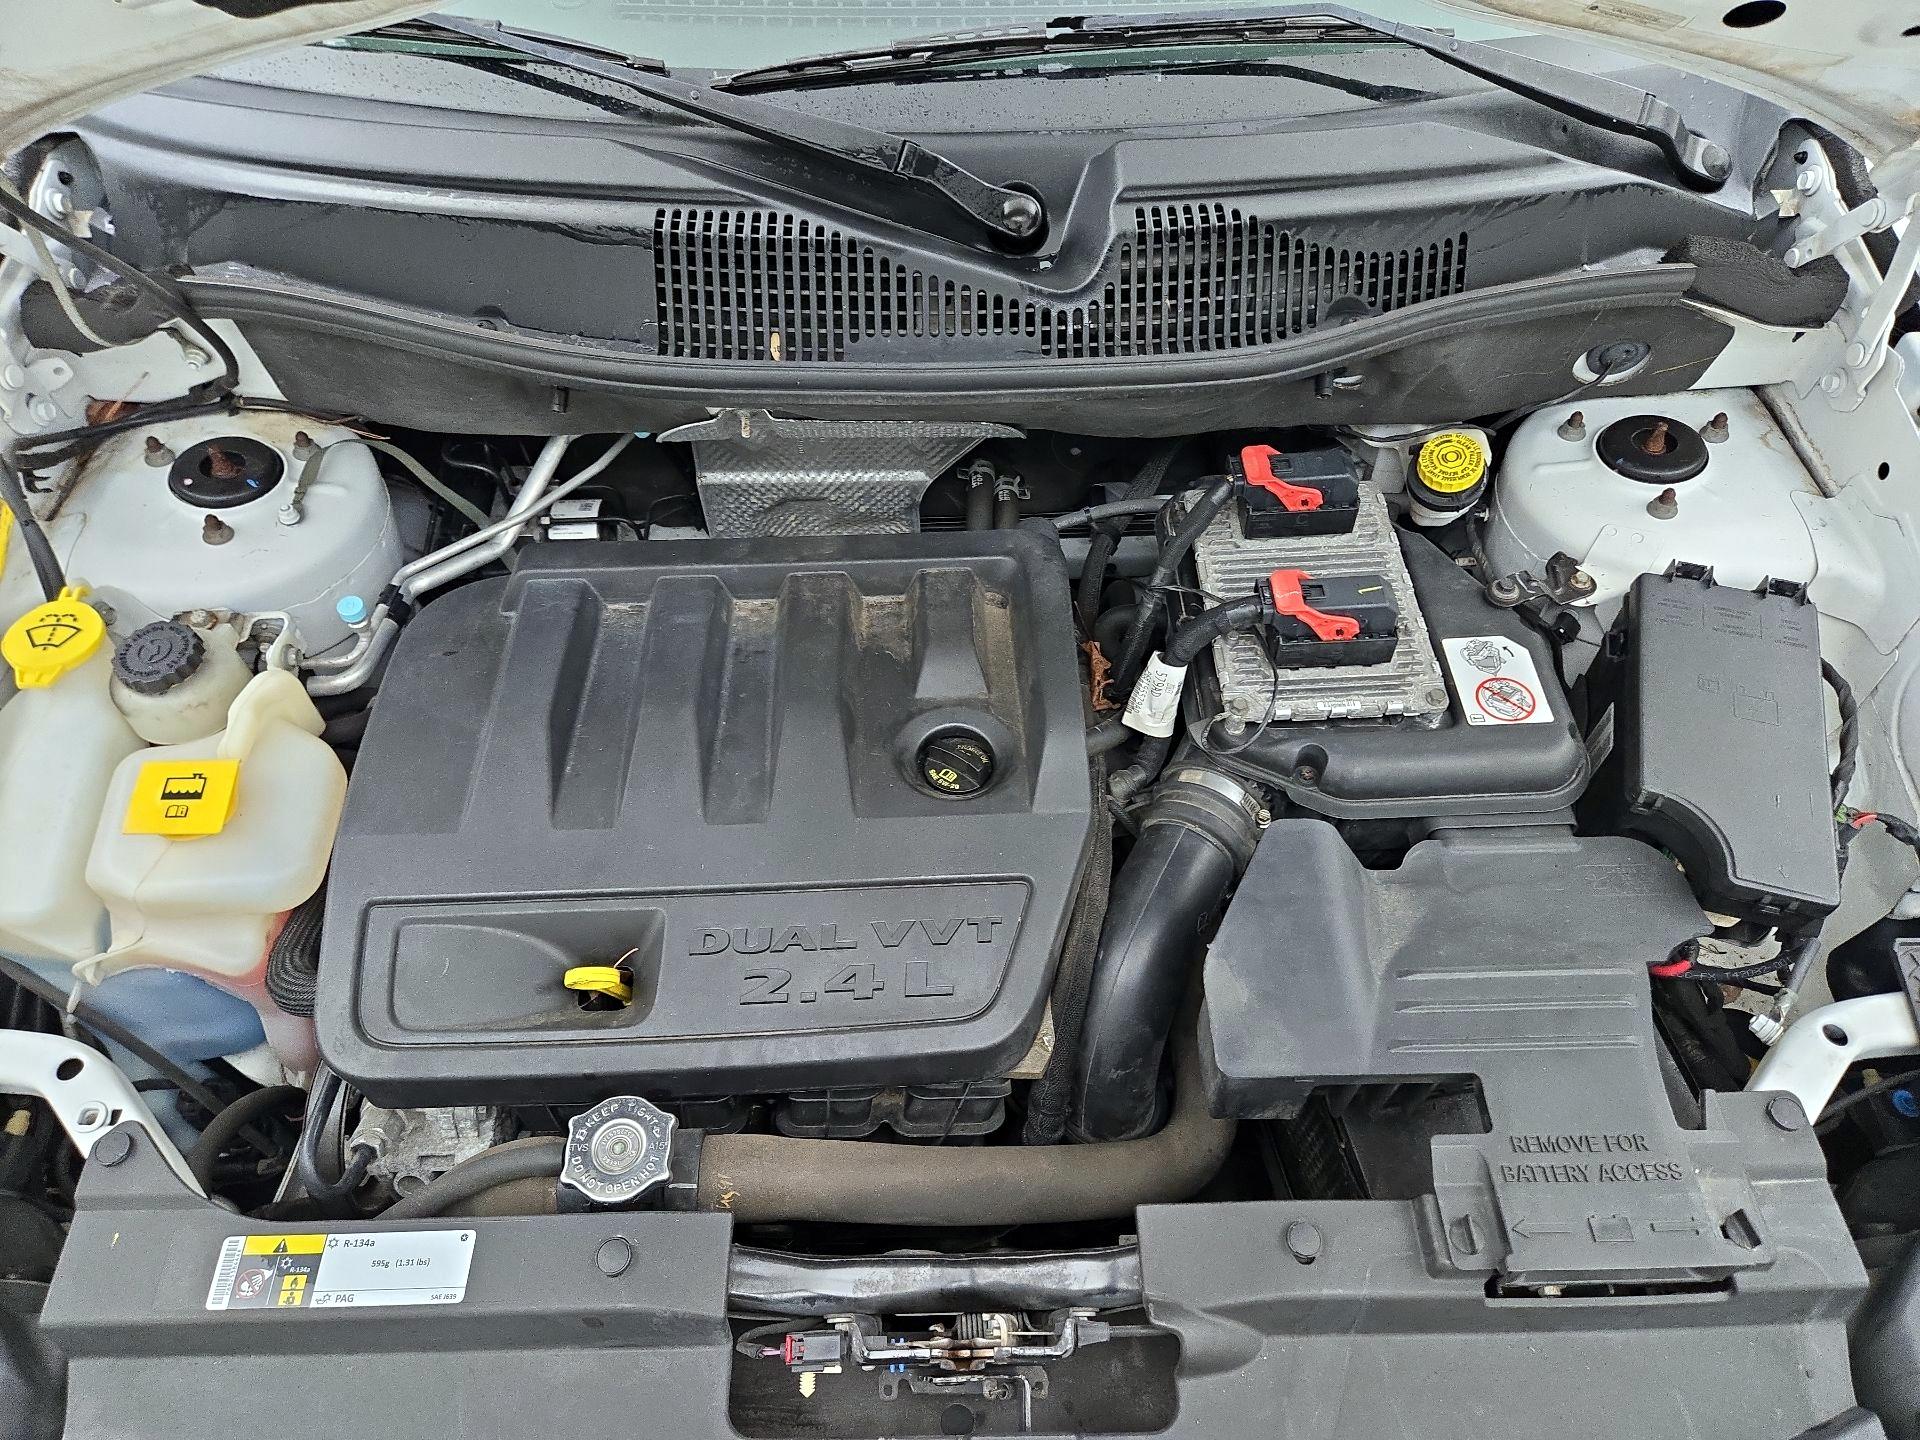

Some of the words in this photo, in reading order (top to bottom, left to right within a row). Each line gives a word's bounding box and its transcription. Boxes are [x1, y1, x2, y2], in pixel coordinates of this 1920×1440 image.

[929, 769, 941, 780] SAE
[937, 778, 960, 789] 5W-20
[689, 924, 857, 955] DUAL
[870, 916, 1003, 948] VVT
[739, 962, 885, 1006] 2.4
[904, 960, 954, 998] L
[585, 1103, 619, 1127] KEEP
[628, 1103, 659, 1125] TIGHT
[570, 1143, 589, 1152] TVS
[1509, 1134, 1601, 1153] REMOVE
[1603, 1134, 1650, 1152] FOR
[571, 1156, 584, 1173] DO
[580, 1172, 604, 1191] NOT
[605, 1176, 640, 1194] OPEN
[639, 1156, 660, 1179] HOT
[1500, 1163, 1589, 1183] BATTERY
[1600, 1162, 1683, 1182] ACCESS
[343, 1238, 376, 1248] R-134a
[371, 1259, 390, 1269] 595g
[395, 1258, 414, 1268] (1.31
[416, 1257, 431, 1267] lbs)
[335, 1293, 355, 1303] PAG
